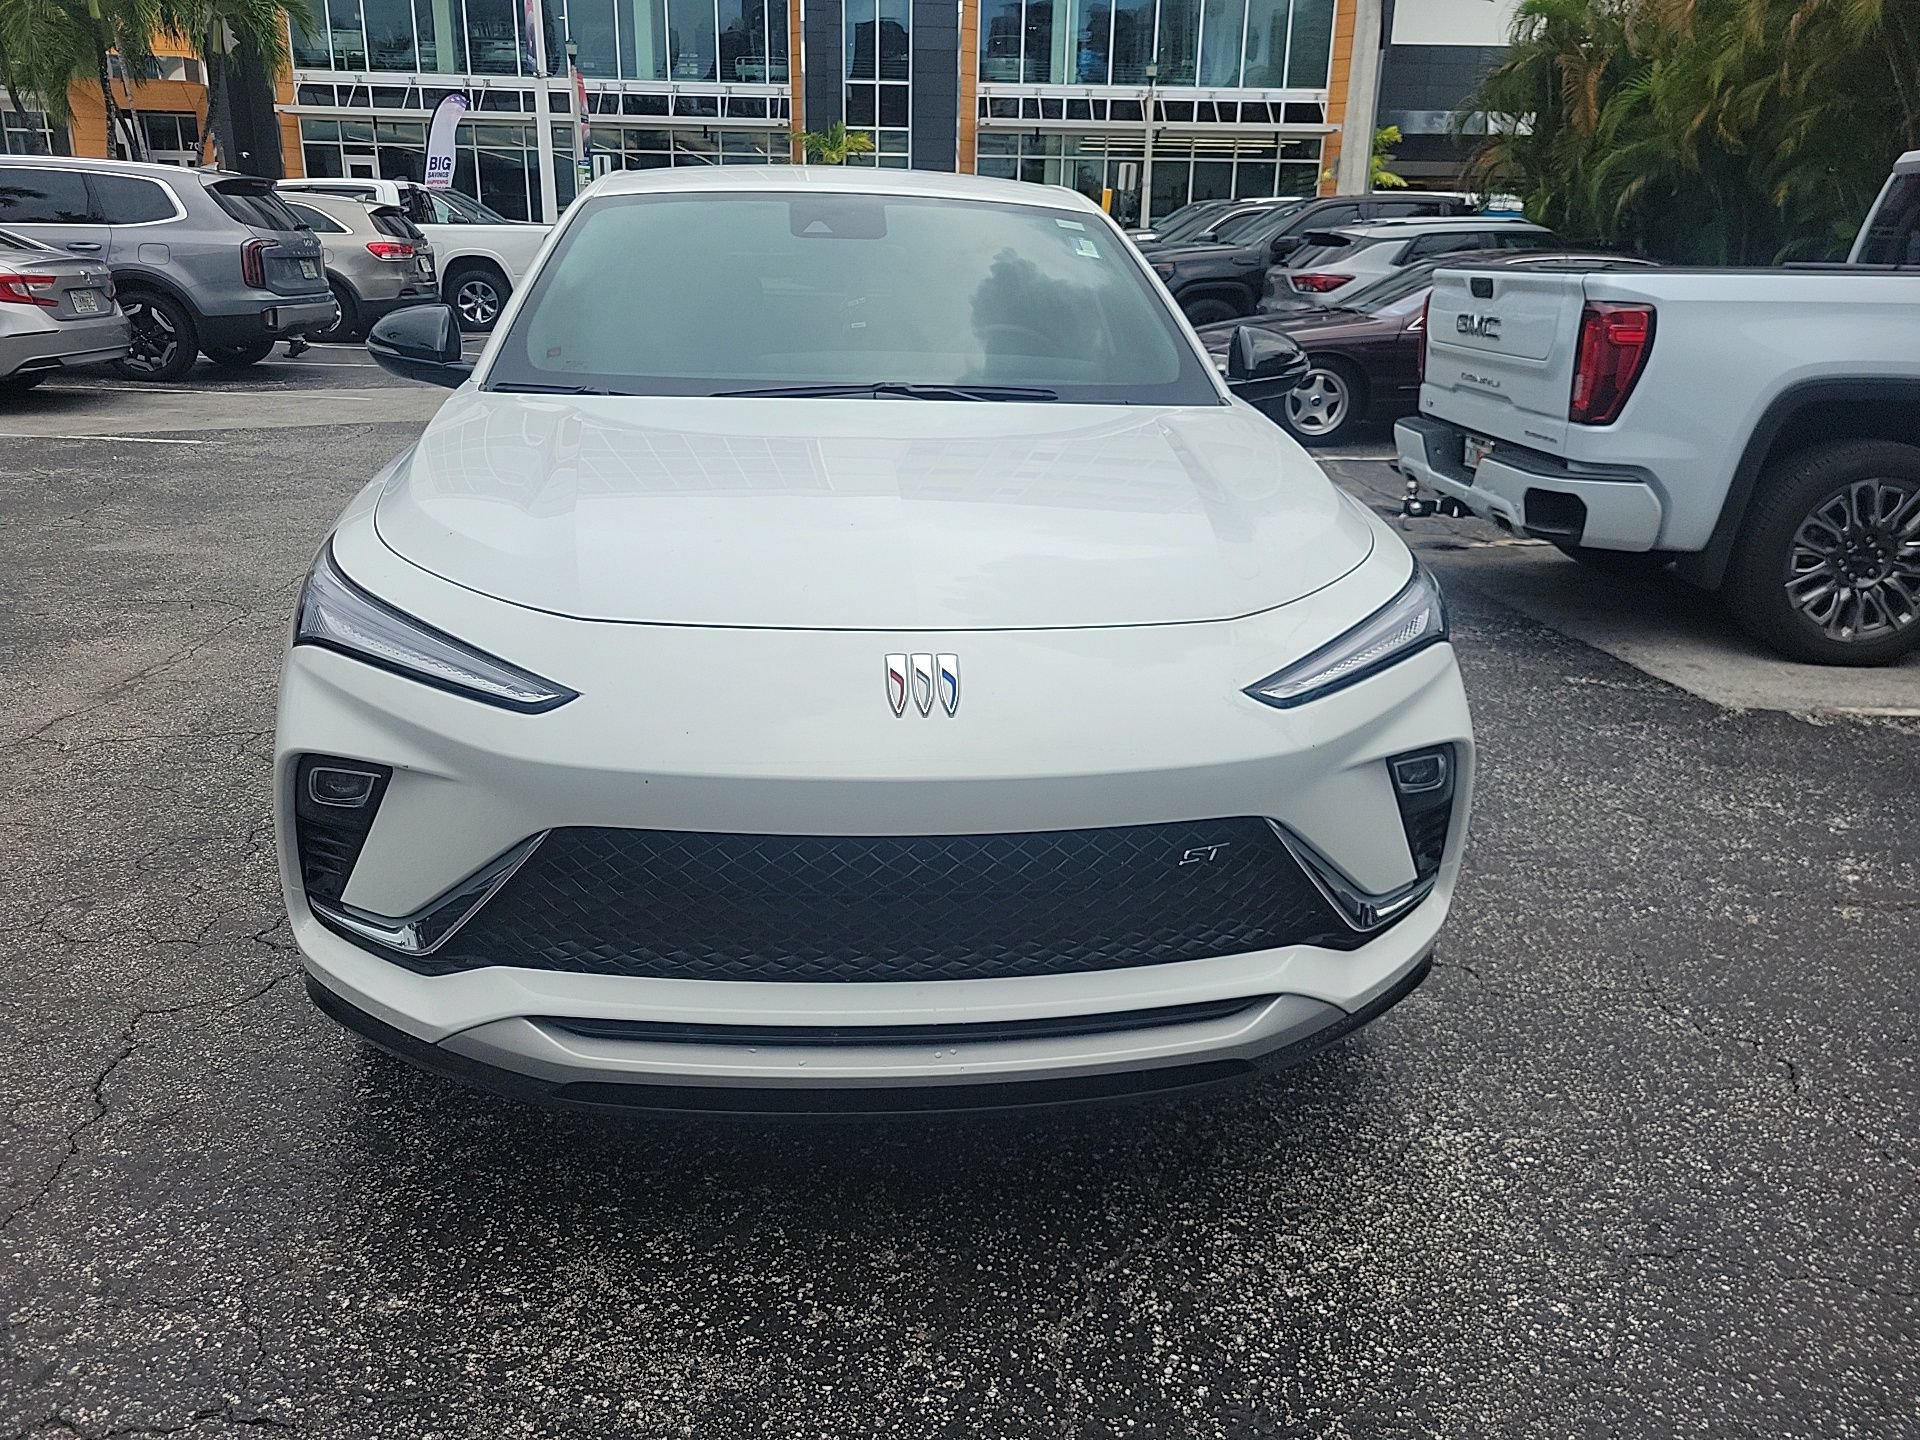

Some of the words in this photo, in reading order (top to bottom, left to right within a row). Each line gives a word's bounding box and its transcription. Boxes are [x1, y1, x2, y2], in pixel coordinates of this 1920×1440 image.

[429, 156, 452, 171] BIG
[1456, 314, 1502, 341] GMC
[1178, 841, 1231, 867] ST
